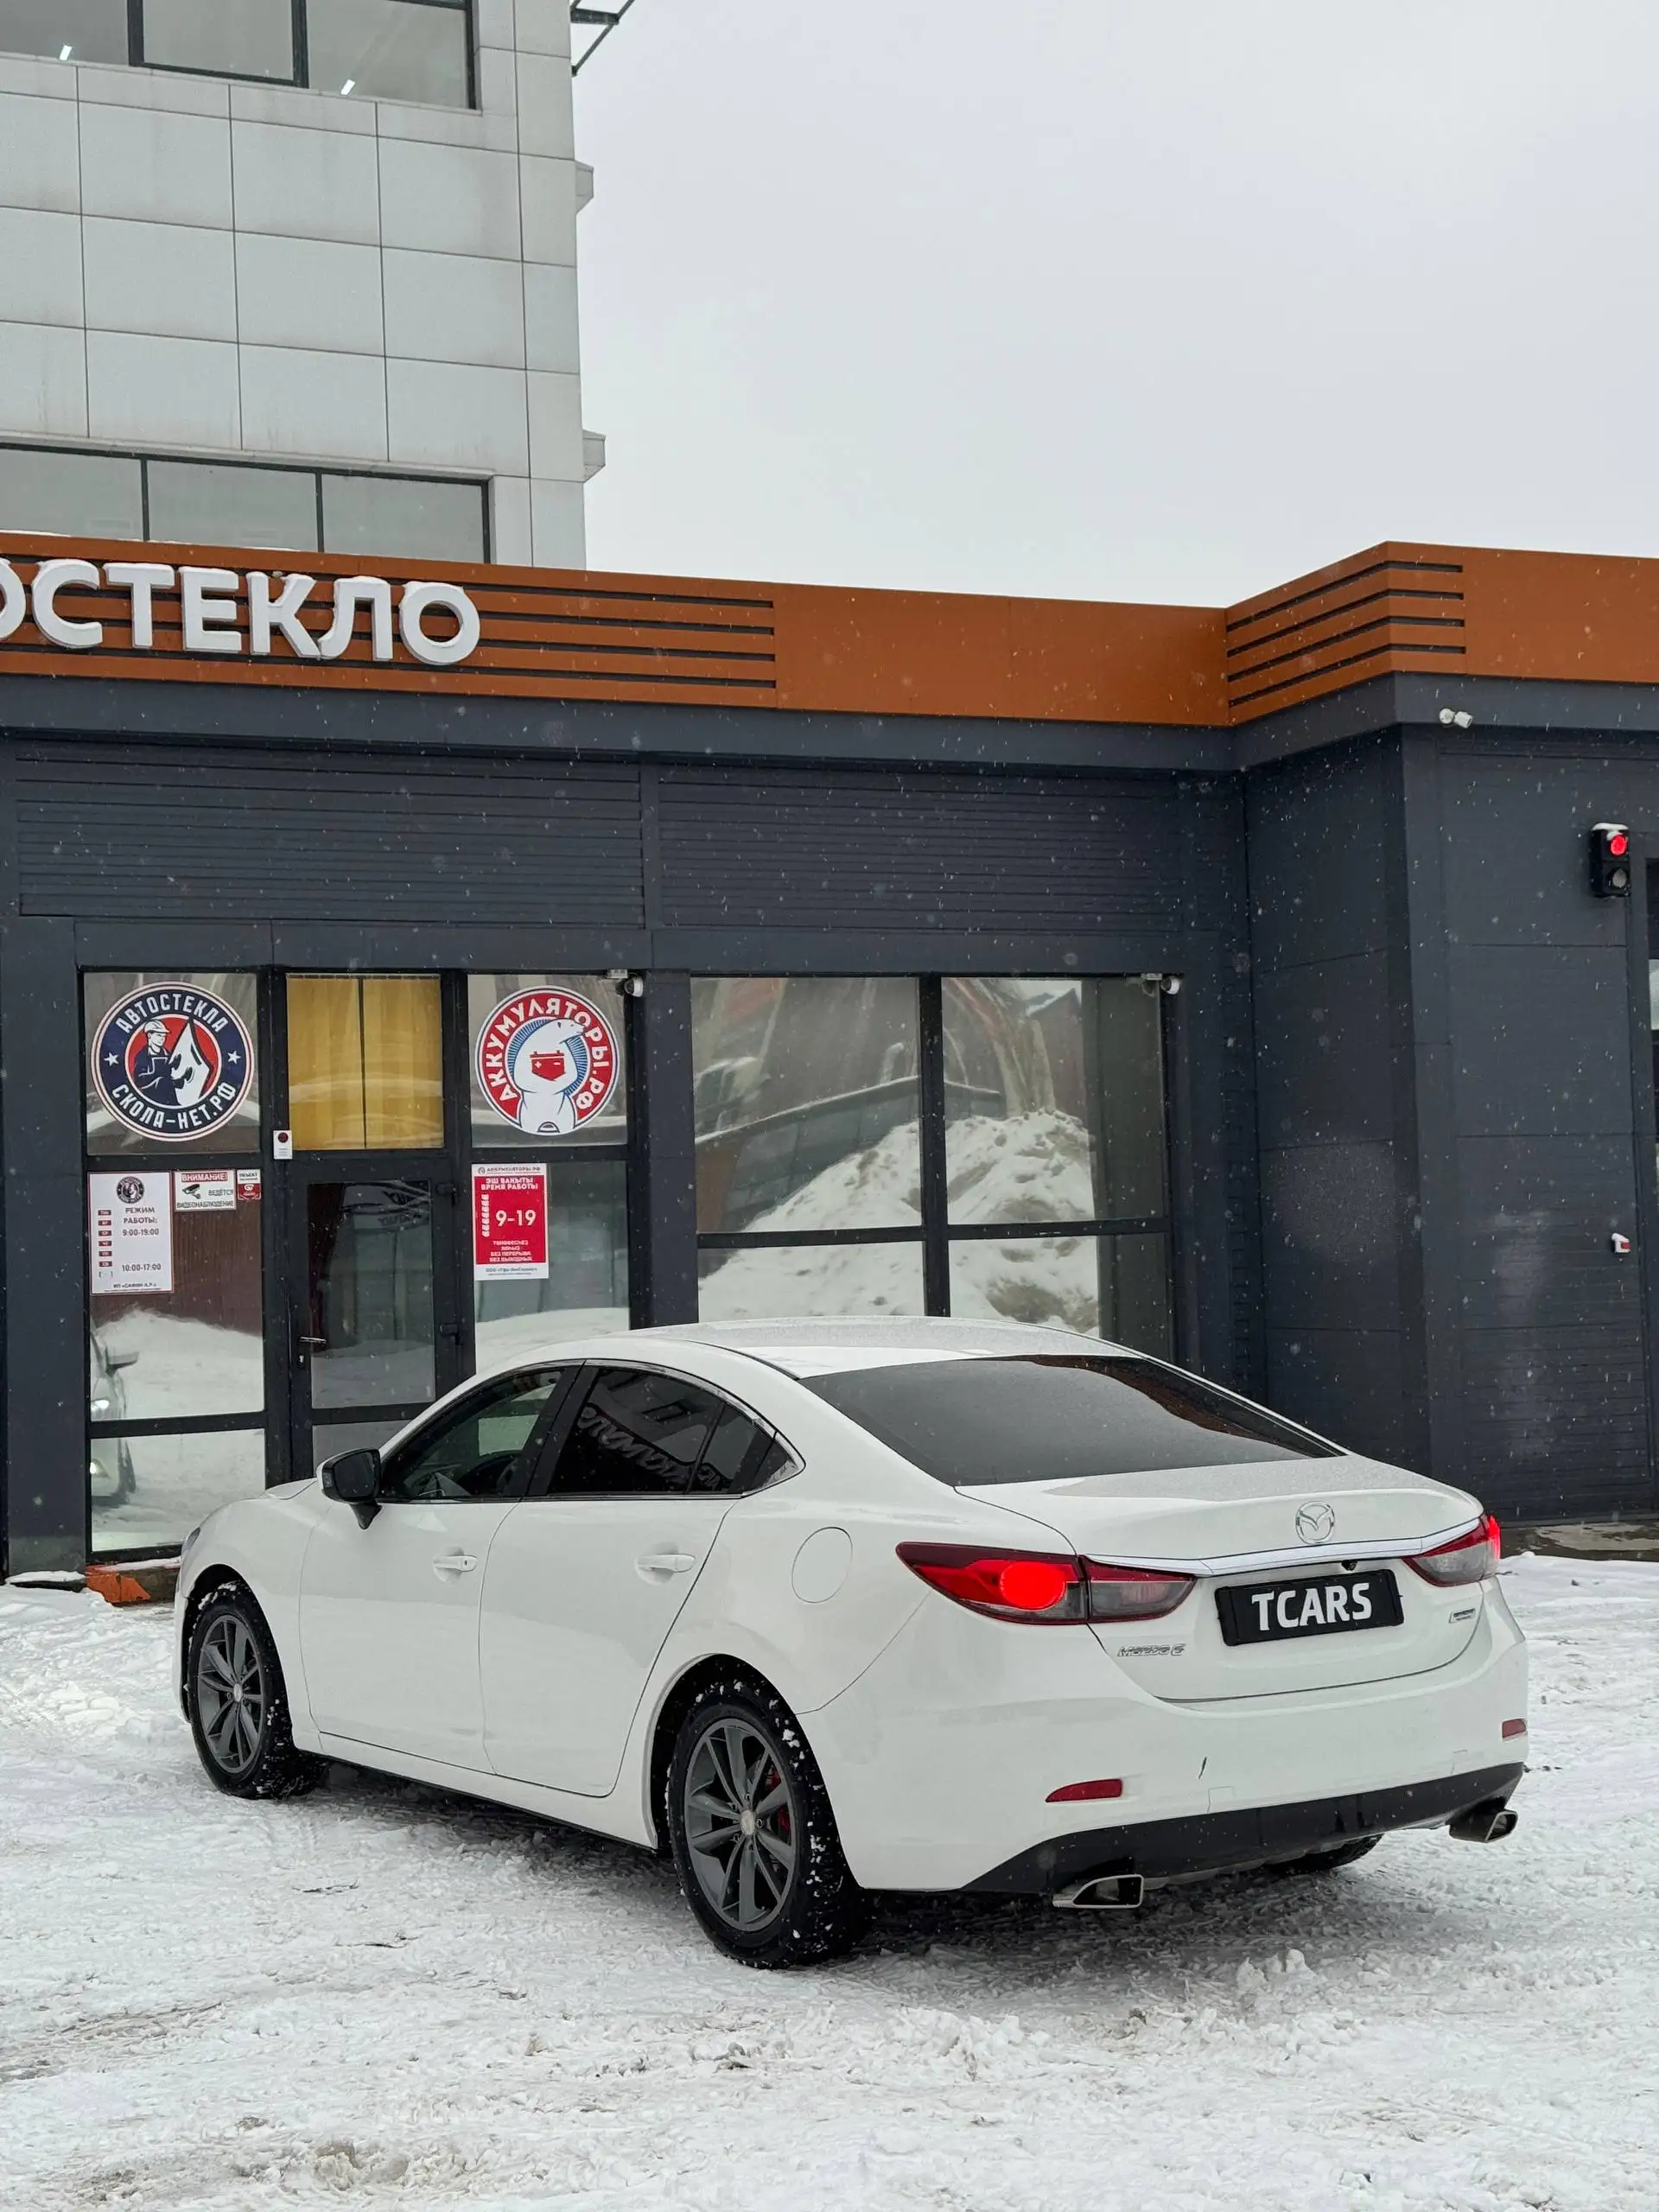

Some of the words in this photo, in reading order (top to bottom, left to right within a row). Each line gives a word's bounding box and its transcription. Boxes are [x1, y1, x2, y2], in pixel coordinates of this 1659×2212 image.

[115, 993, 229, 1033] АВТОСТЕКЛА
[486, 997, 610, 1110] АККУМУЛЯТОРЫ.РФ
[111, 1081, 237, 1130] СКОЛА-НЕТ.РФ
[182, 1173, 228, 1182] ВНИМАНИЕ!
[122, 1228, 159, 1236] 9:00-19:00
[495, 1210, 537, 1227] 9-19
[122, 1263, 162, 1272] 10:00-17:00
[1251, 1582, 1373, 1631] TCARS
